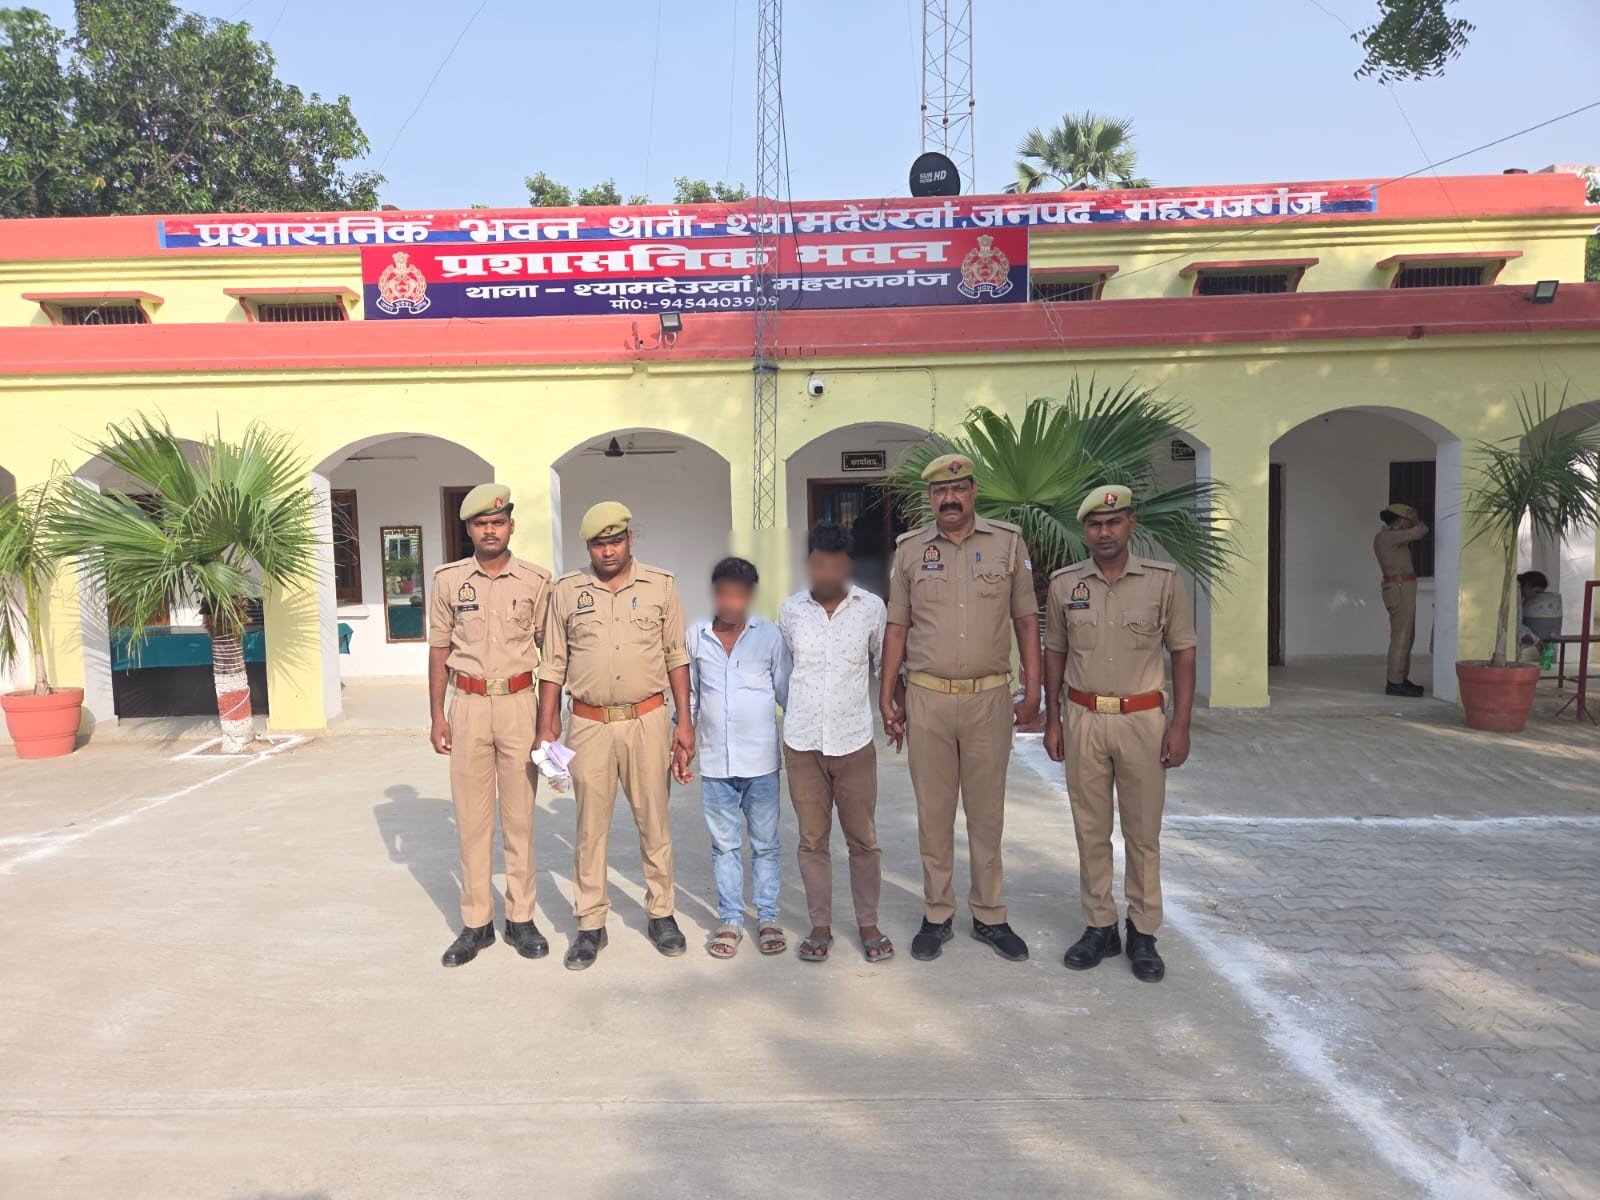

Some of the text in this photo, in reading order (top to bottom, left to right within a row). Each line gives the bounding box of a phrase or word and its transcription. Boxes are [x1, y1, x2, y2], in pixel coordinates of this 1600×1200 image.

[933, 170, 947, 182] HD
[193, 216, 432, 247] प्रशासनिक
[459, 218, 584, 243] भवन
[970, 201, 1097, 228] जनपद
[1121, 188, 1328, 220] महराजगंज
[434, 241, 952, 278] प्रशासनिक भवन
[465, 285, 539, 299] थाना
[771, 270, 951, 291] महराजगंज
